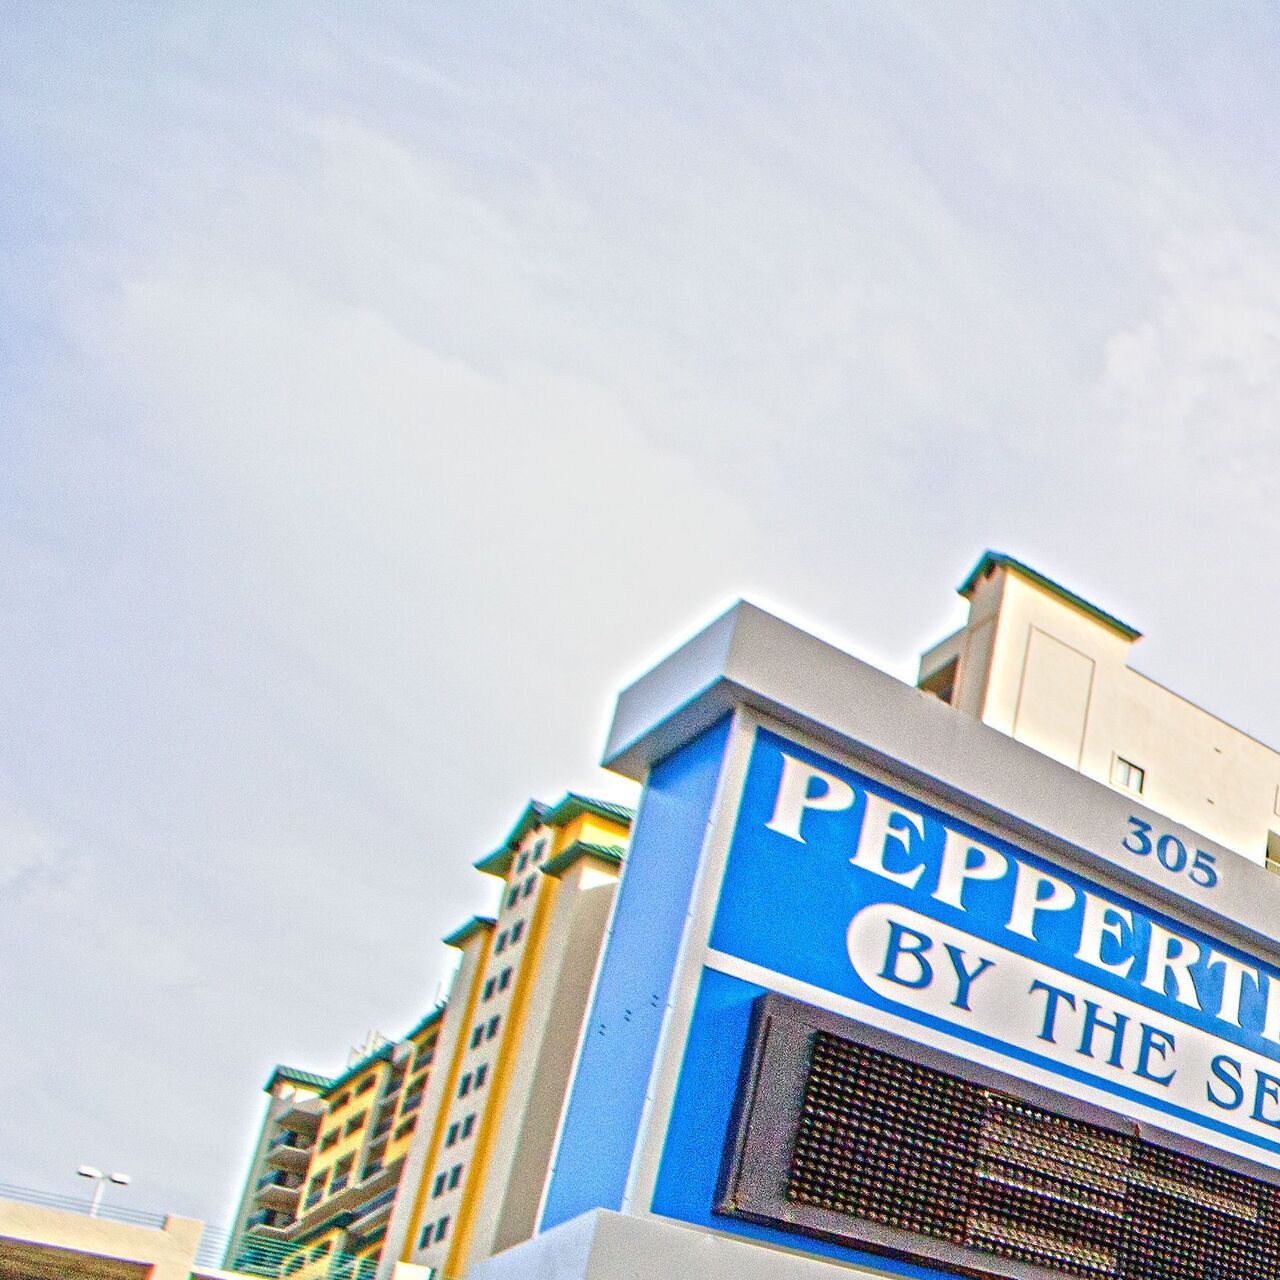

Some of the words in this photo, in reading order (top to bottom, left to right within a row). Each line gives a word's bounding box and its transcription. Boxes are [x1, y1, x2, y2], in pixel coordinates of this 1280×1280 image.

[1121, 815, 1220, 889] 305
[876, 918, 998, 1011] BY
[1028, 978, 1178, 1087] THE
